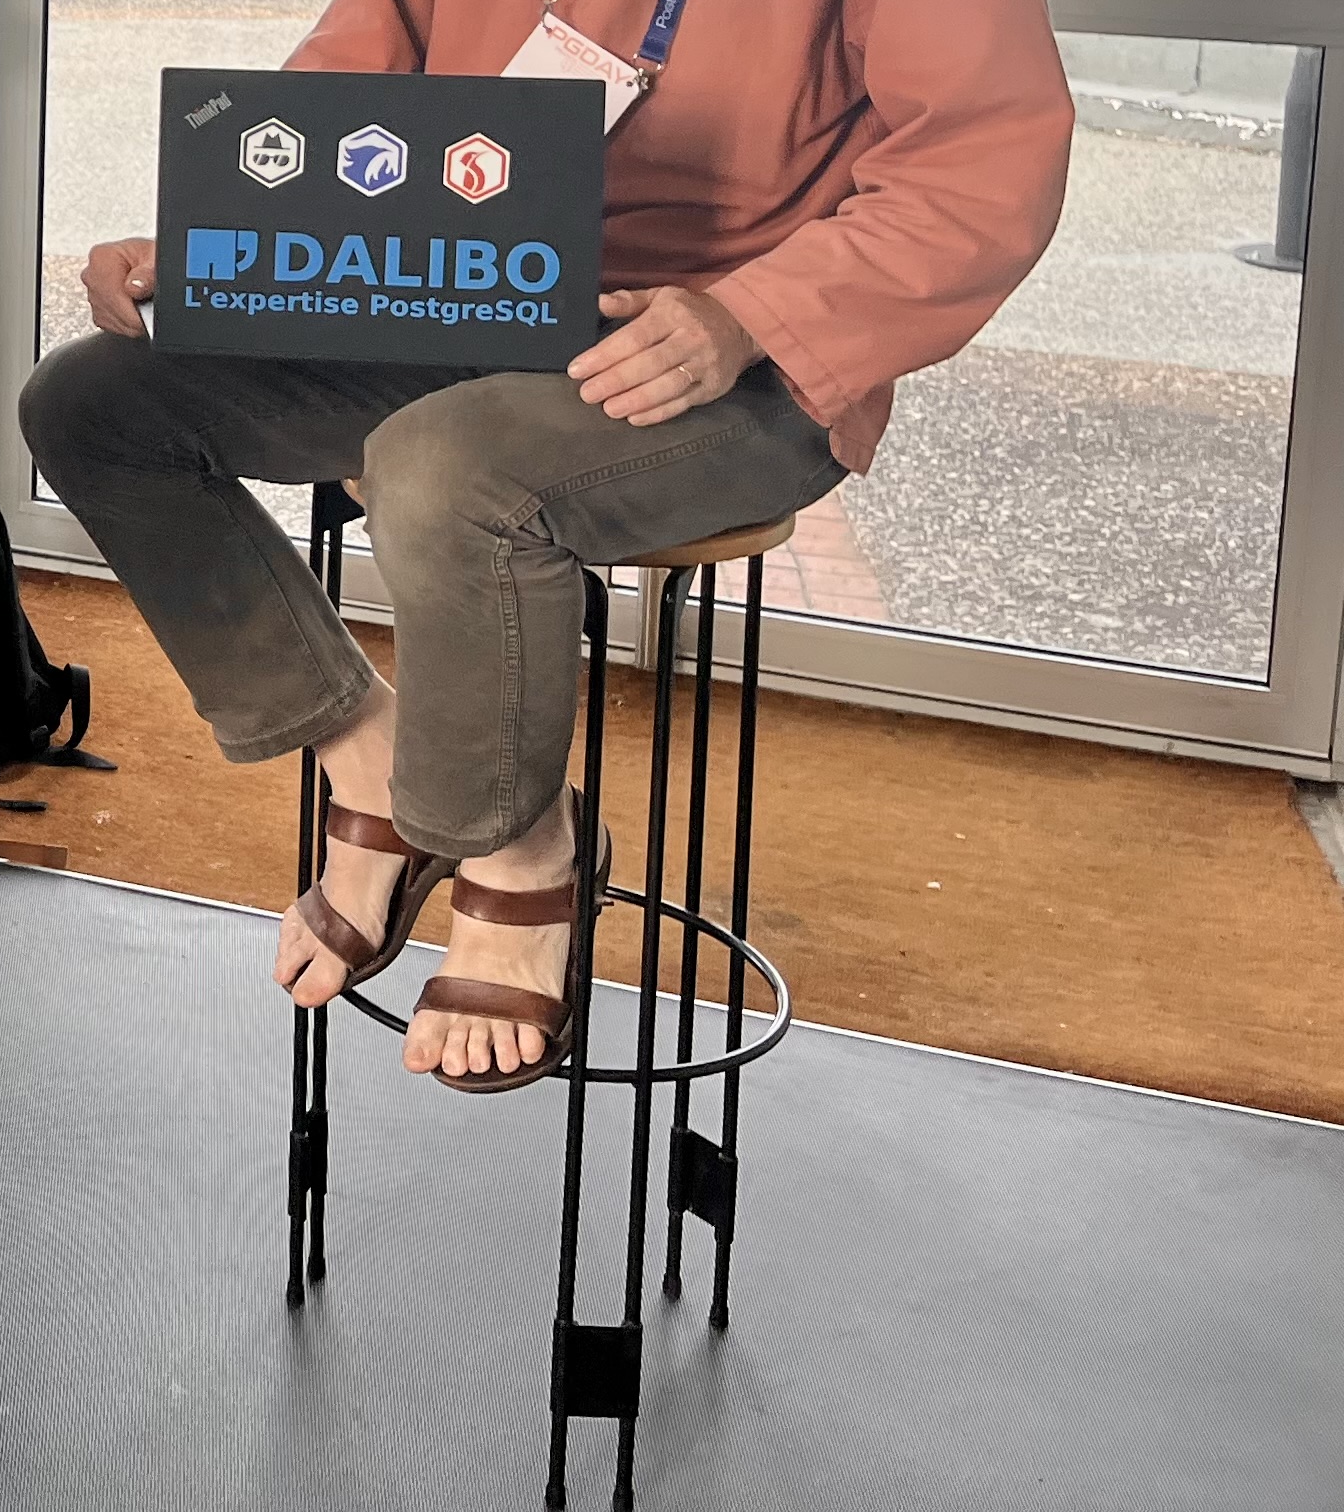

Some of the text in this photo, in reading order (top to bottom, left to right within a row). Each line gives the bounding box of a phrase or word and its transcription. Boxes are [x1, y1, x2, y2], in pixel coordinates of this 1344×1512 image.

[547, 26, 632, 84] PGDAY
[184, 90, 233, 130] ThinkPad
[273, 230, 561, 294] DALIBO
[184, 285, 558, 327] L'expertise PostgreSQL
